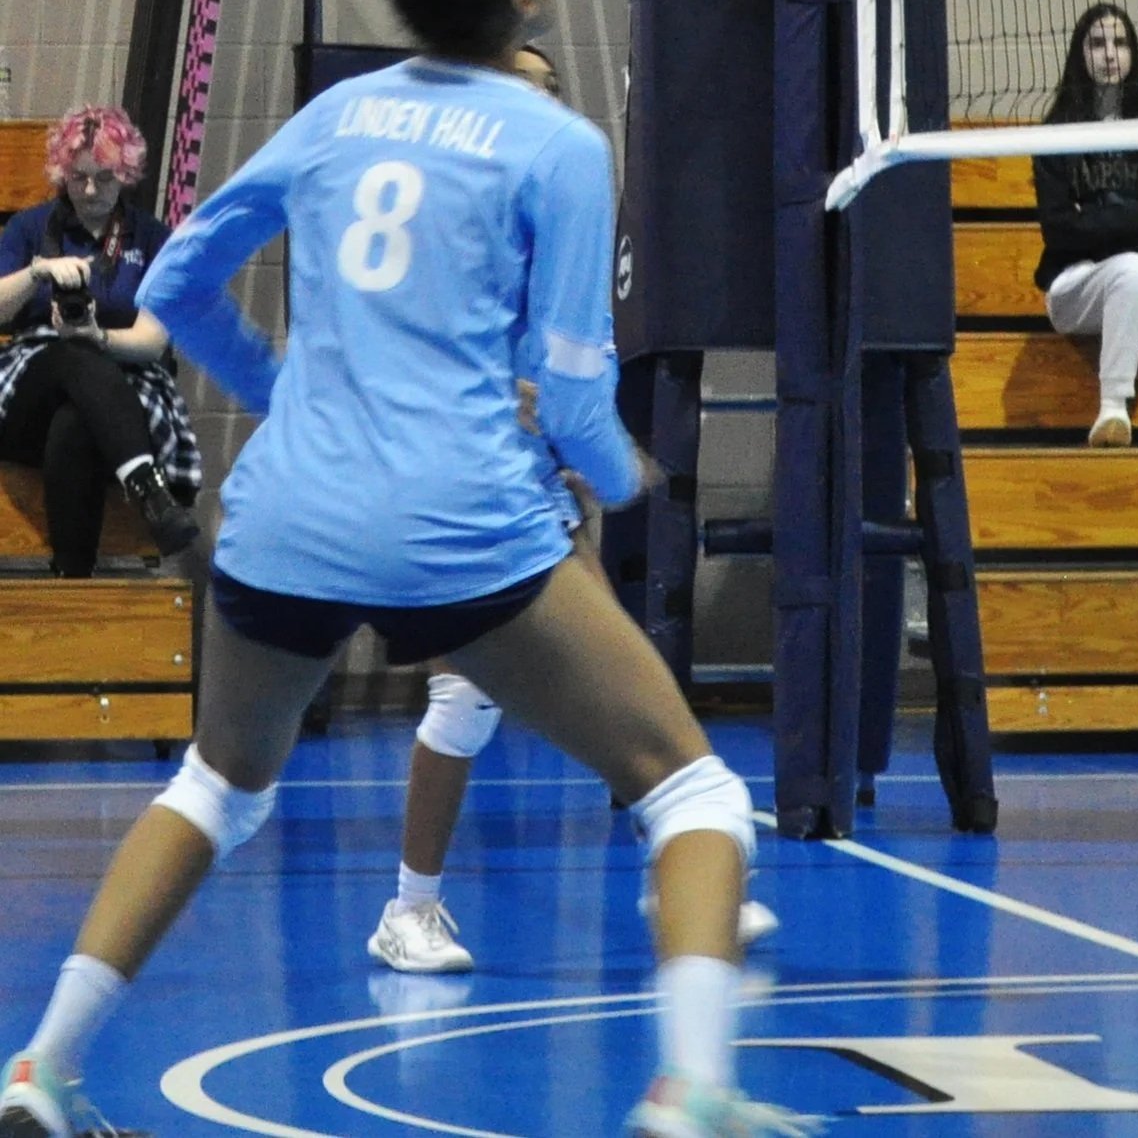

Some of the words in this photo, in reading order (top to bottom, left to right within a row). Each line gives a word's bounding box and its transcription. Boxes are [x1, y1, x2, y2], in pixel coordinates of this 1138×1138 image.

[335, 96, 437, 144] LINDEN
[428, 104, 505, 159] HALL
[337, 160, 425, 291] 8
